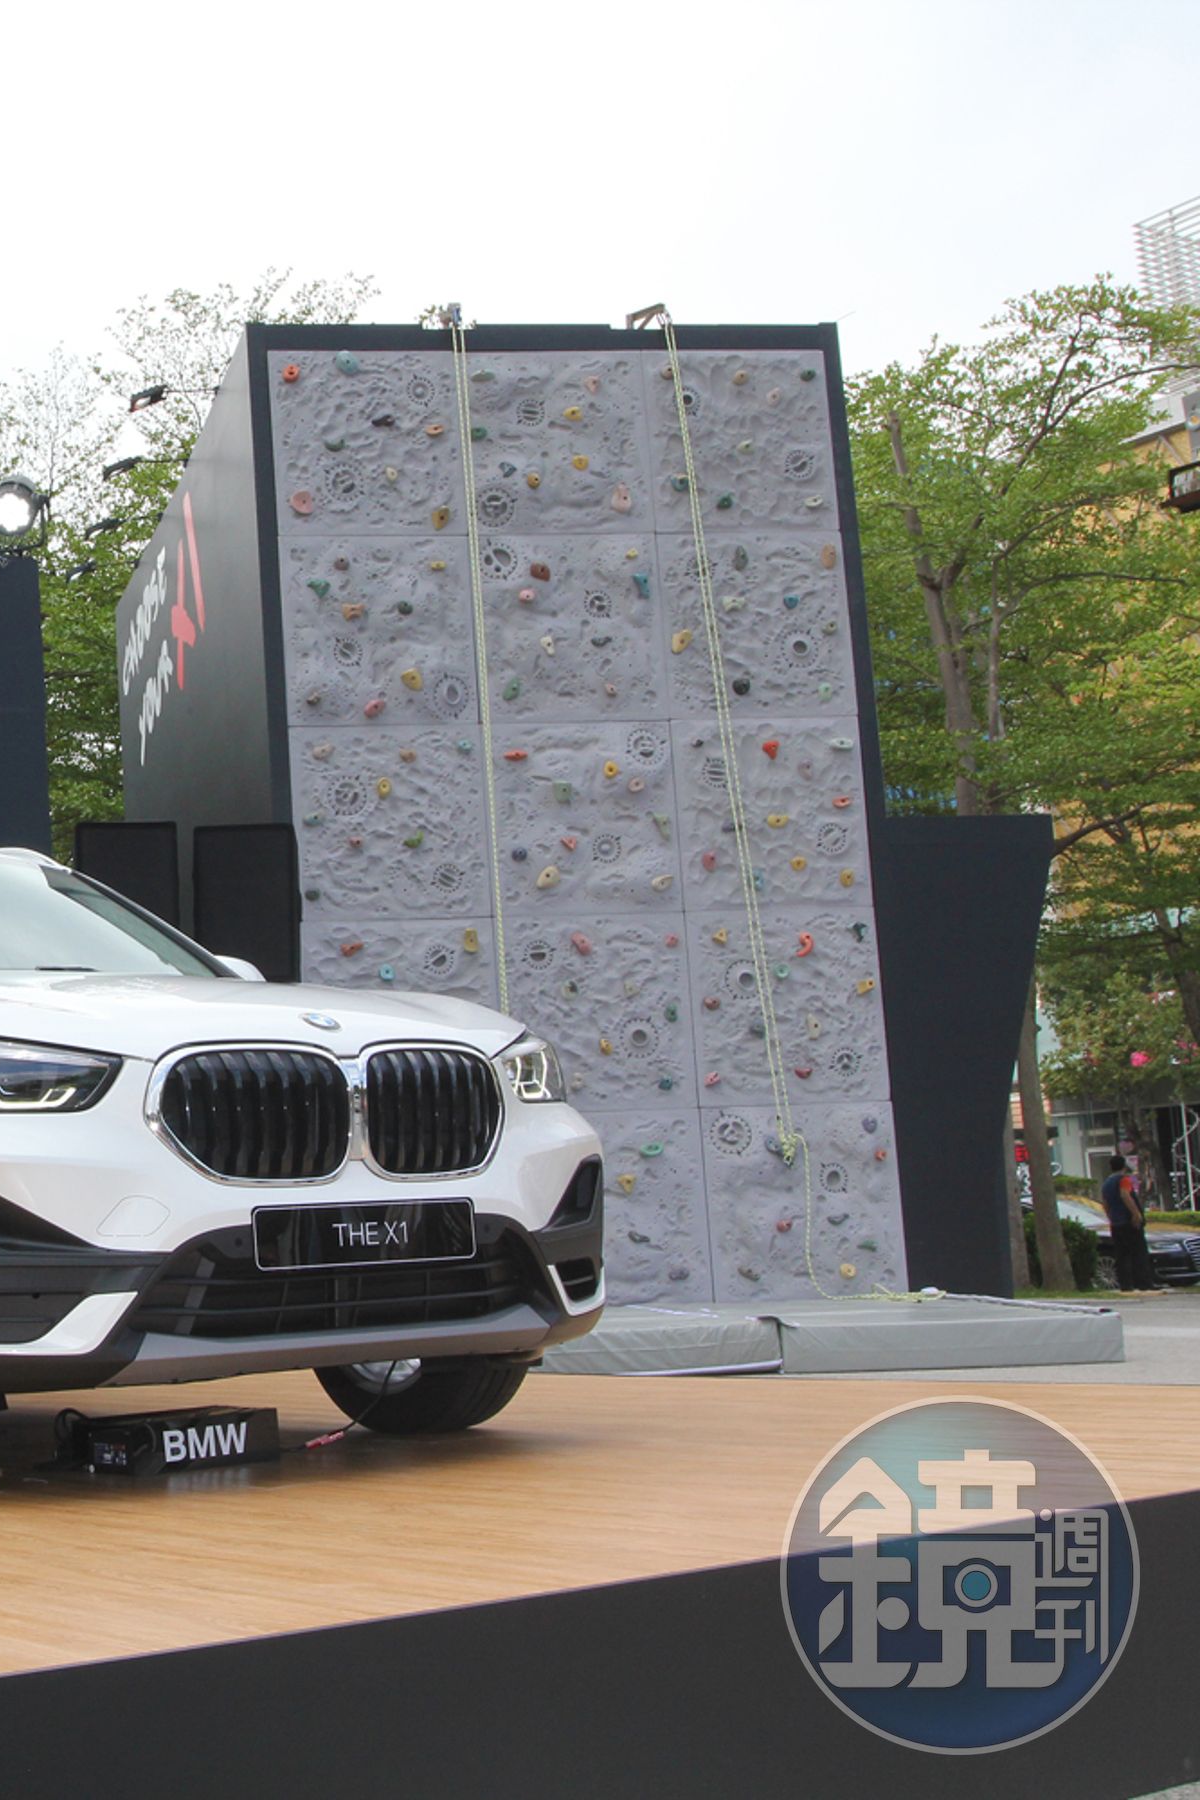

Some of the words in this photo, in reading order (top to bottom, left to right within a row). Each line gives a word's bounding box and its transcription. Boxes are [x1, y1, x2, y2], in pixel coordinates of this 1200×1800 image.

[122, 546, 168, 696] CHOOSE
[332, 1221, 380, 1247] THE
[383, 1221, 409, 1244] X1
[162, 1421, 248, 1463] BMW
